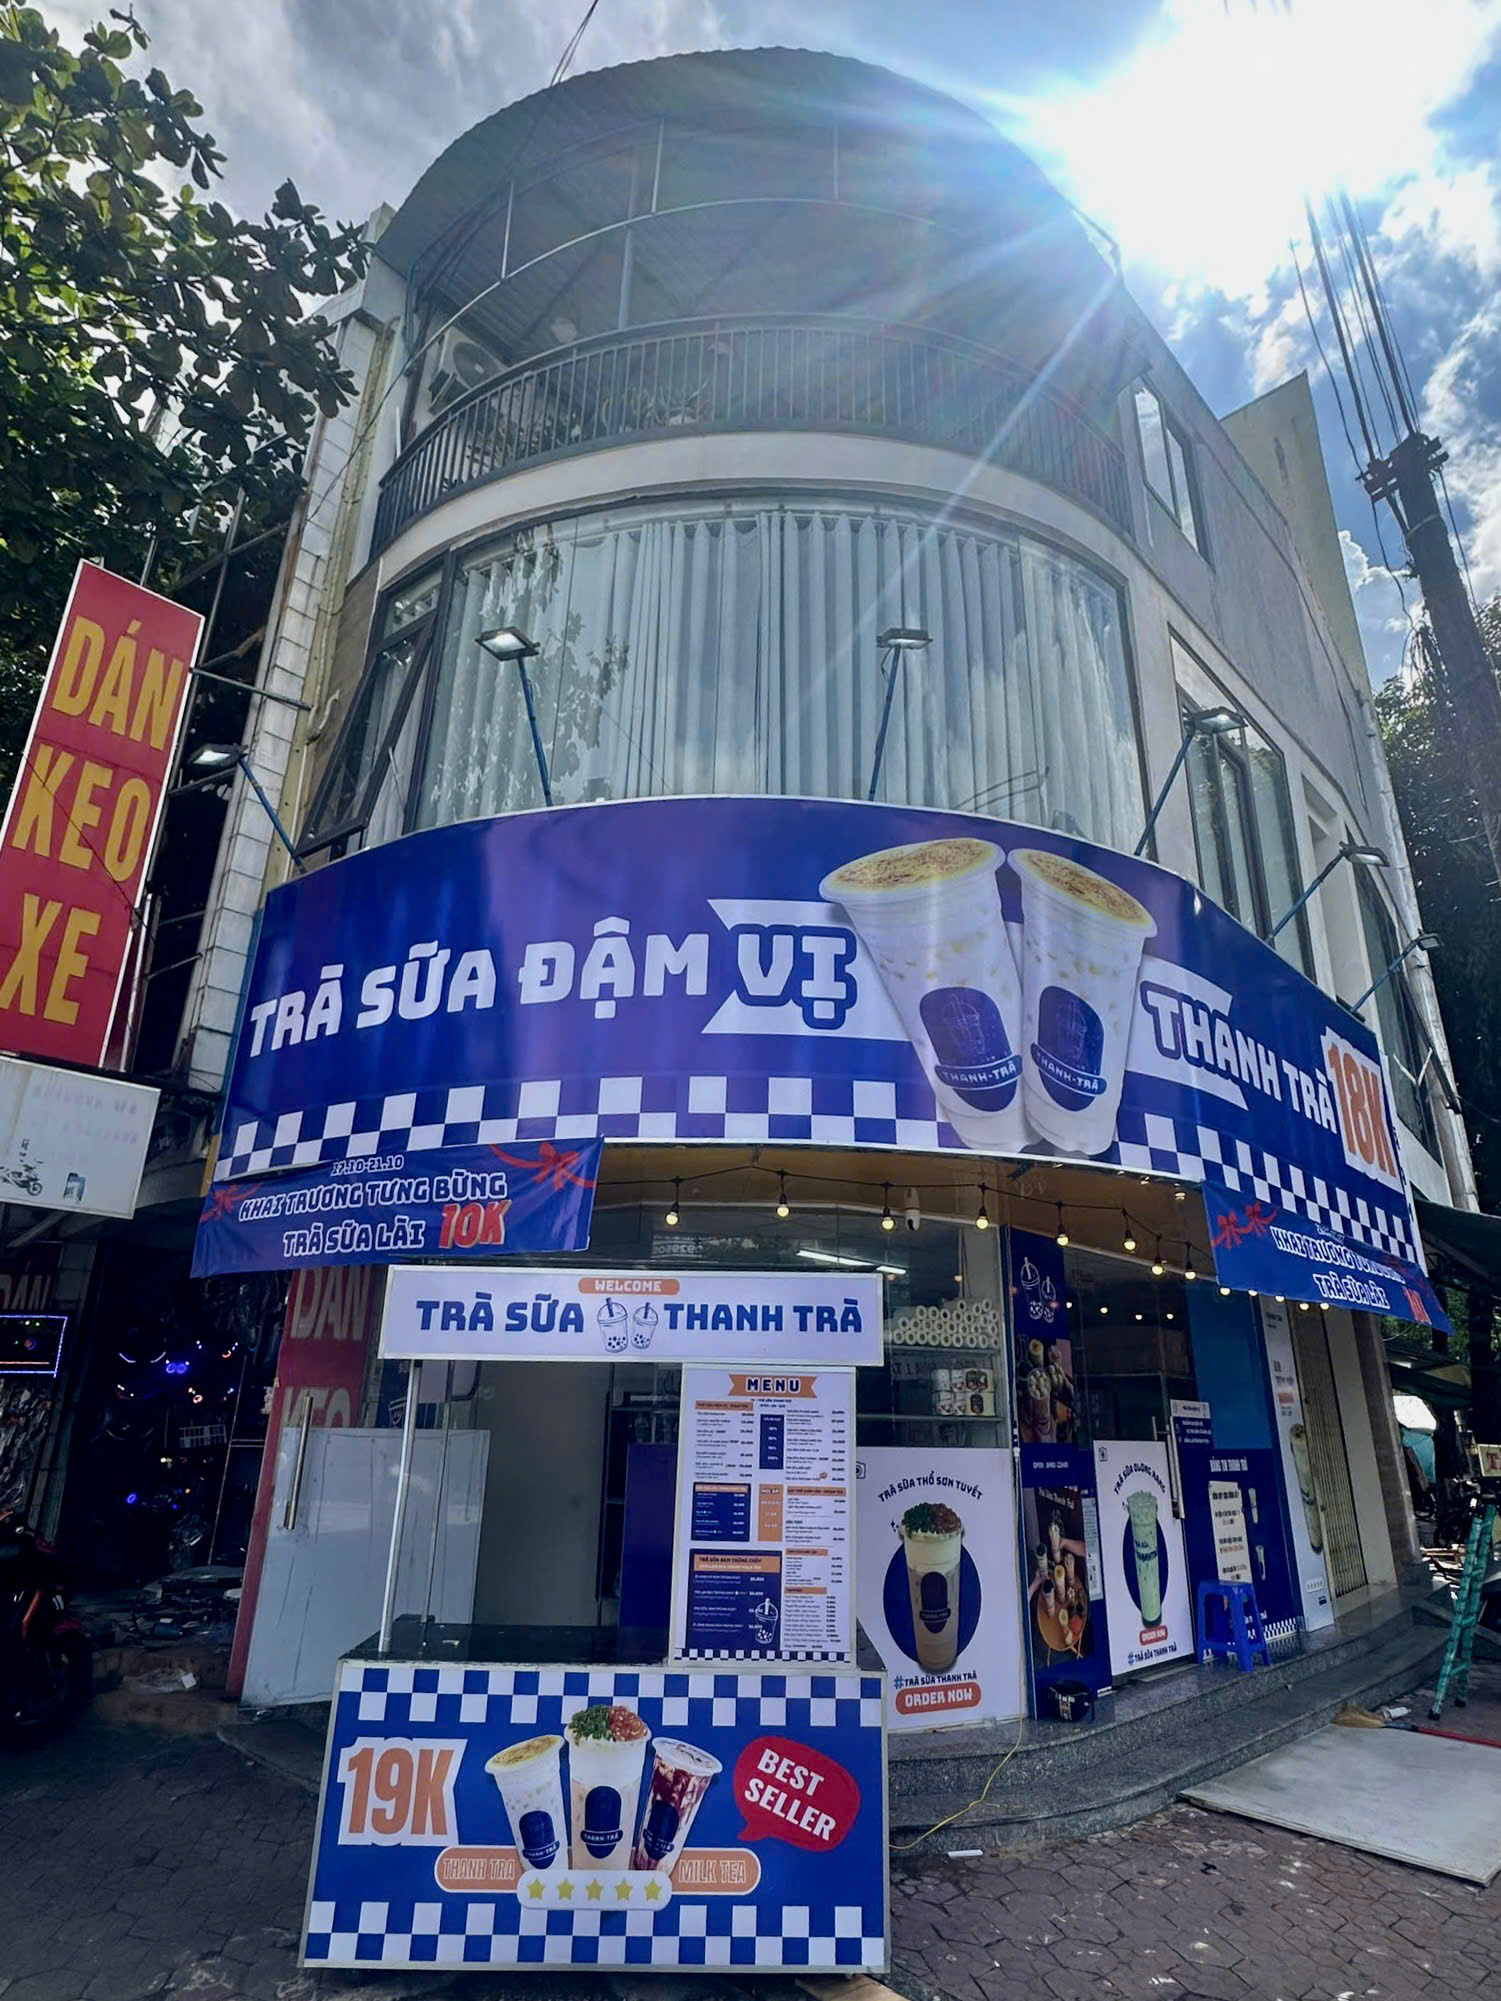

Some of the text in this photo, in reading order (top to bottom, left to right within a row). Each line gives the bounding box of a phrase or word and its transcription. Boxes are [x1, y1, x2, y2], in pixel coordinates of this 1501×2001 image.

[51, 615, 184, 752] DÁN
[11, 743, 151, 882] KEO
[0, 893, 101, 1026] XE
[250, 916, 852, 1057] TRÀ SỮA ĐẬM VỊ
[1144, 987, 1282, 1102] THANH
[1281, 1058, 1338, 1135] TRÀ
[1327, 1041, 1398, 1178] 18K
[238, 1192, 284, 1222] KHAI
[365, 1177, 429, 1206] TƯNG
[432, 1169, 509, 1201] BỪNG
[282, 1200, 511, 1258] TRÀ SỮA LÀI 10K
[594, 1279, 662, 1293] WELCOME
[416, 1292, 863, 1333] TRÀ SỮA THANH TRÀ
[747, 1378, 800, 1392] MENU
[916, 1470, 935, 1486] THỔ
[956, 1480, 983, 1500] TUYẾT
[905, 1688, 973, 1708] ORDER NOW
[937, 1675, 961, 1684] THANH
[347, 1747, 454, 1836] 19K
[757, 1748, 824, 1796] BEST
[744, 1778, 836, 1841] SELLER
[443, 1858, 515, 1881] THANH TRA
[678, 1859, 746, 1883] MILK TEA
